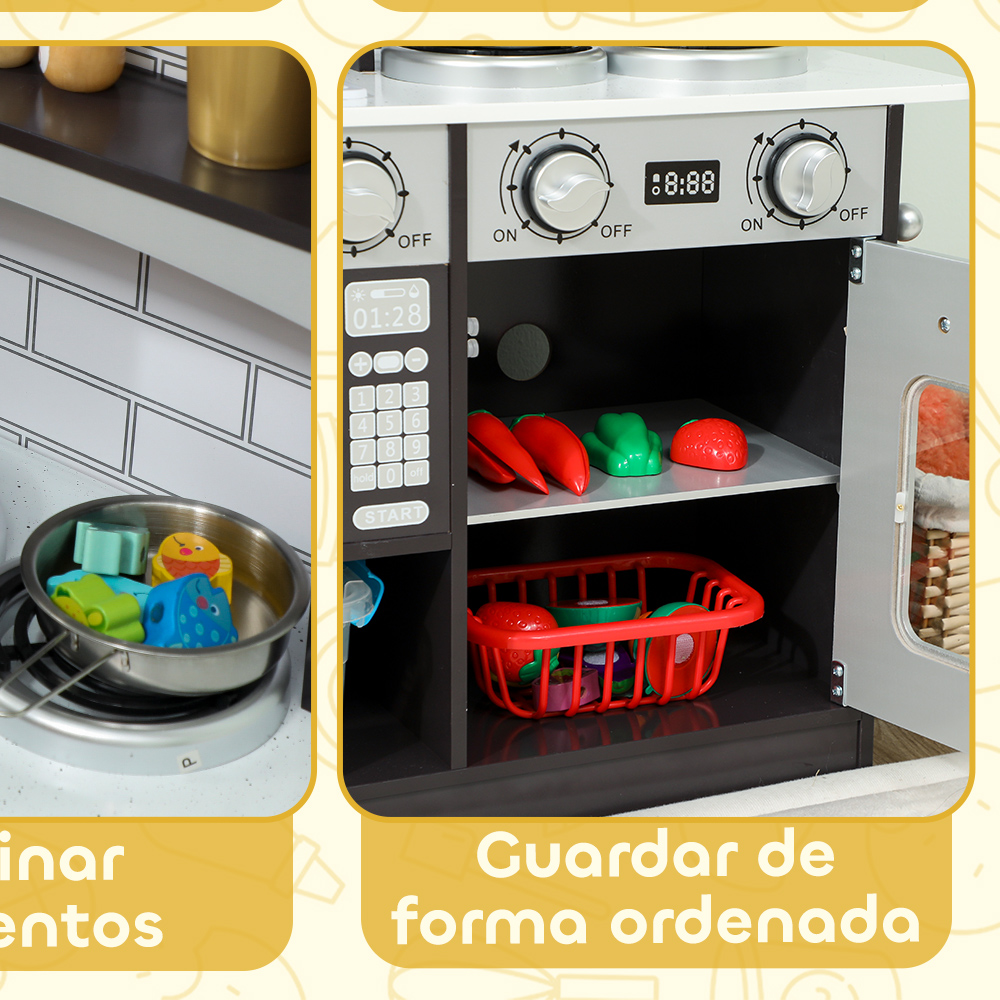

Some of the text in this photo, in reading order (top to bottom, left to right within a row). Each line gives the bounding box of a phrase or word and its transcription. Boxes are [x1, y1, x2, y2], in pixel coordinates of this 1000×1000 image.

[839, 206, 869, 221] OFF
[600, 223, 633, 239] OFF
[741, 217, 763, 231] ON
[398, 232, 432, 249] OFF
[492, 228, 517, 243] ON
[353, 303, 422, 330] 01:28
[357, 387, 421, 406] 1 2 3
[357, 412, 421, 432] 4 5 6
[358, 438, 421, 460] 7 8 9
[353, 467, 424, 483] hold 0 off
[365, 506, 424, 524] START
